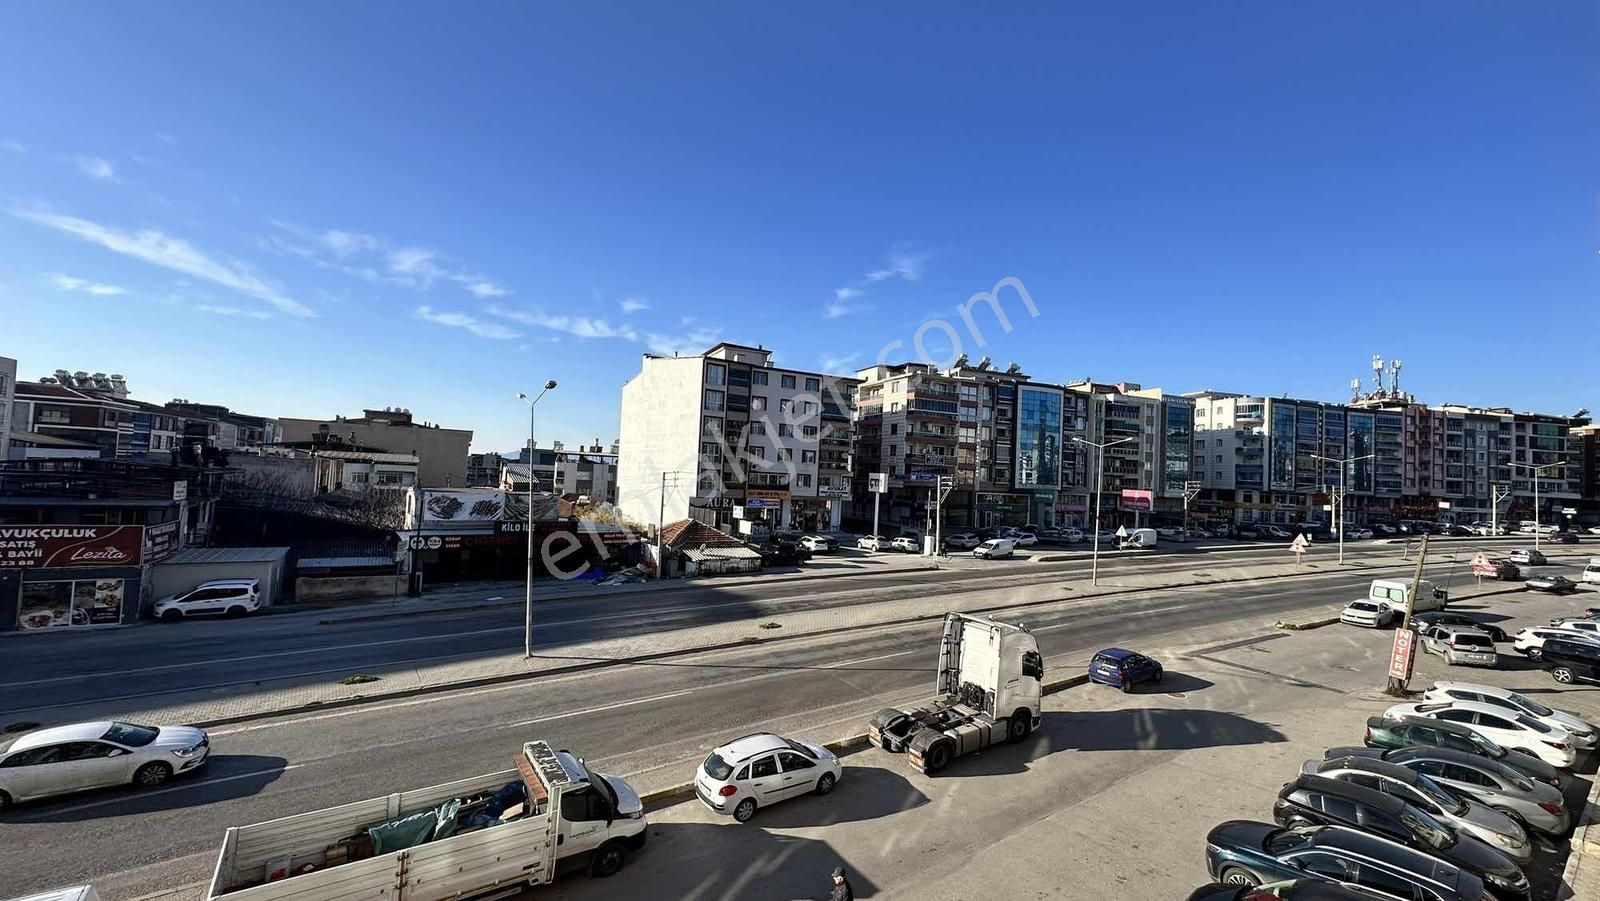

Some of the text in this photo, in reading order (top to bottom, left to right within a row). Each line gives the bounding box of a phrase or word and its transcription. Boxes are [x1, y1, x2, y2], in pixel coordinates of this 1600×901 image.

[706, 498, 735, 508] AURA
[0, 529, 97, 540] VUKÇULUK
[0, 541, 36, 549] SATIŞ
[8, 549, 43, 558] BAYİİ
[70, 546, 127, 561] Lezita
[1394, 630, 1409, 672] NOTER
